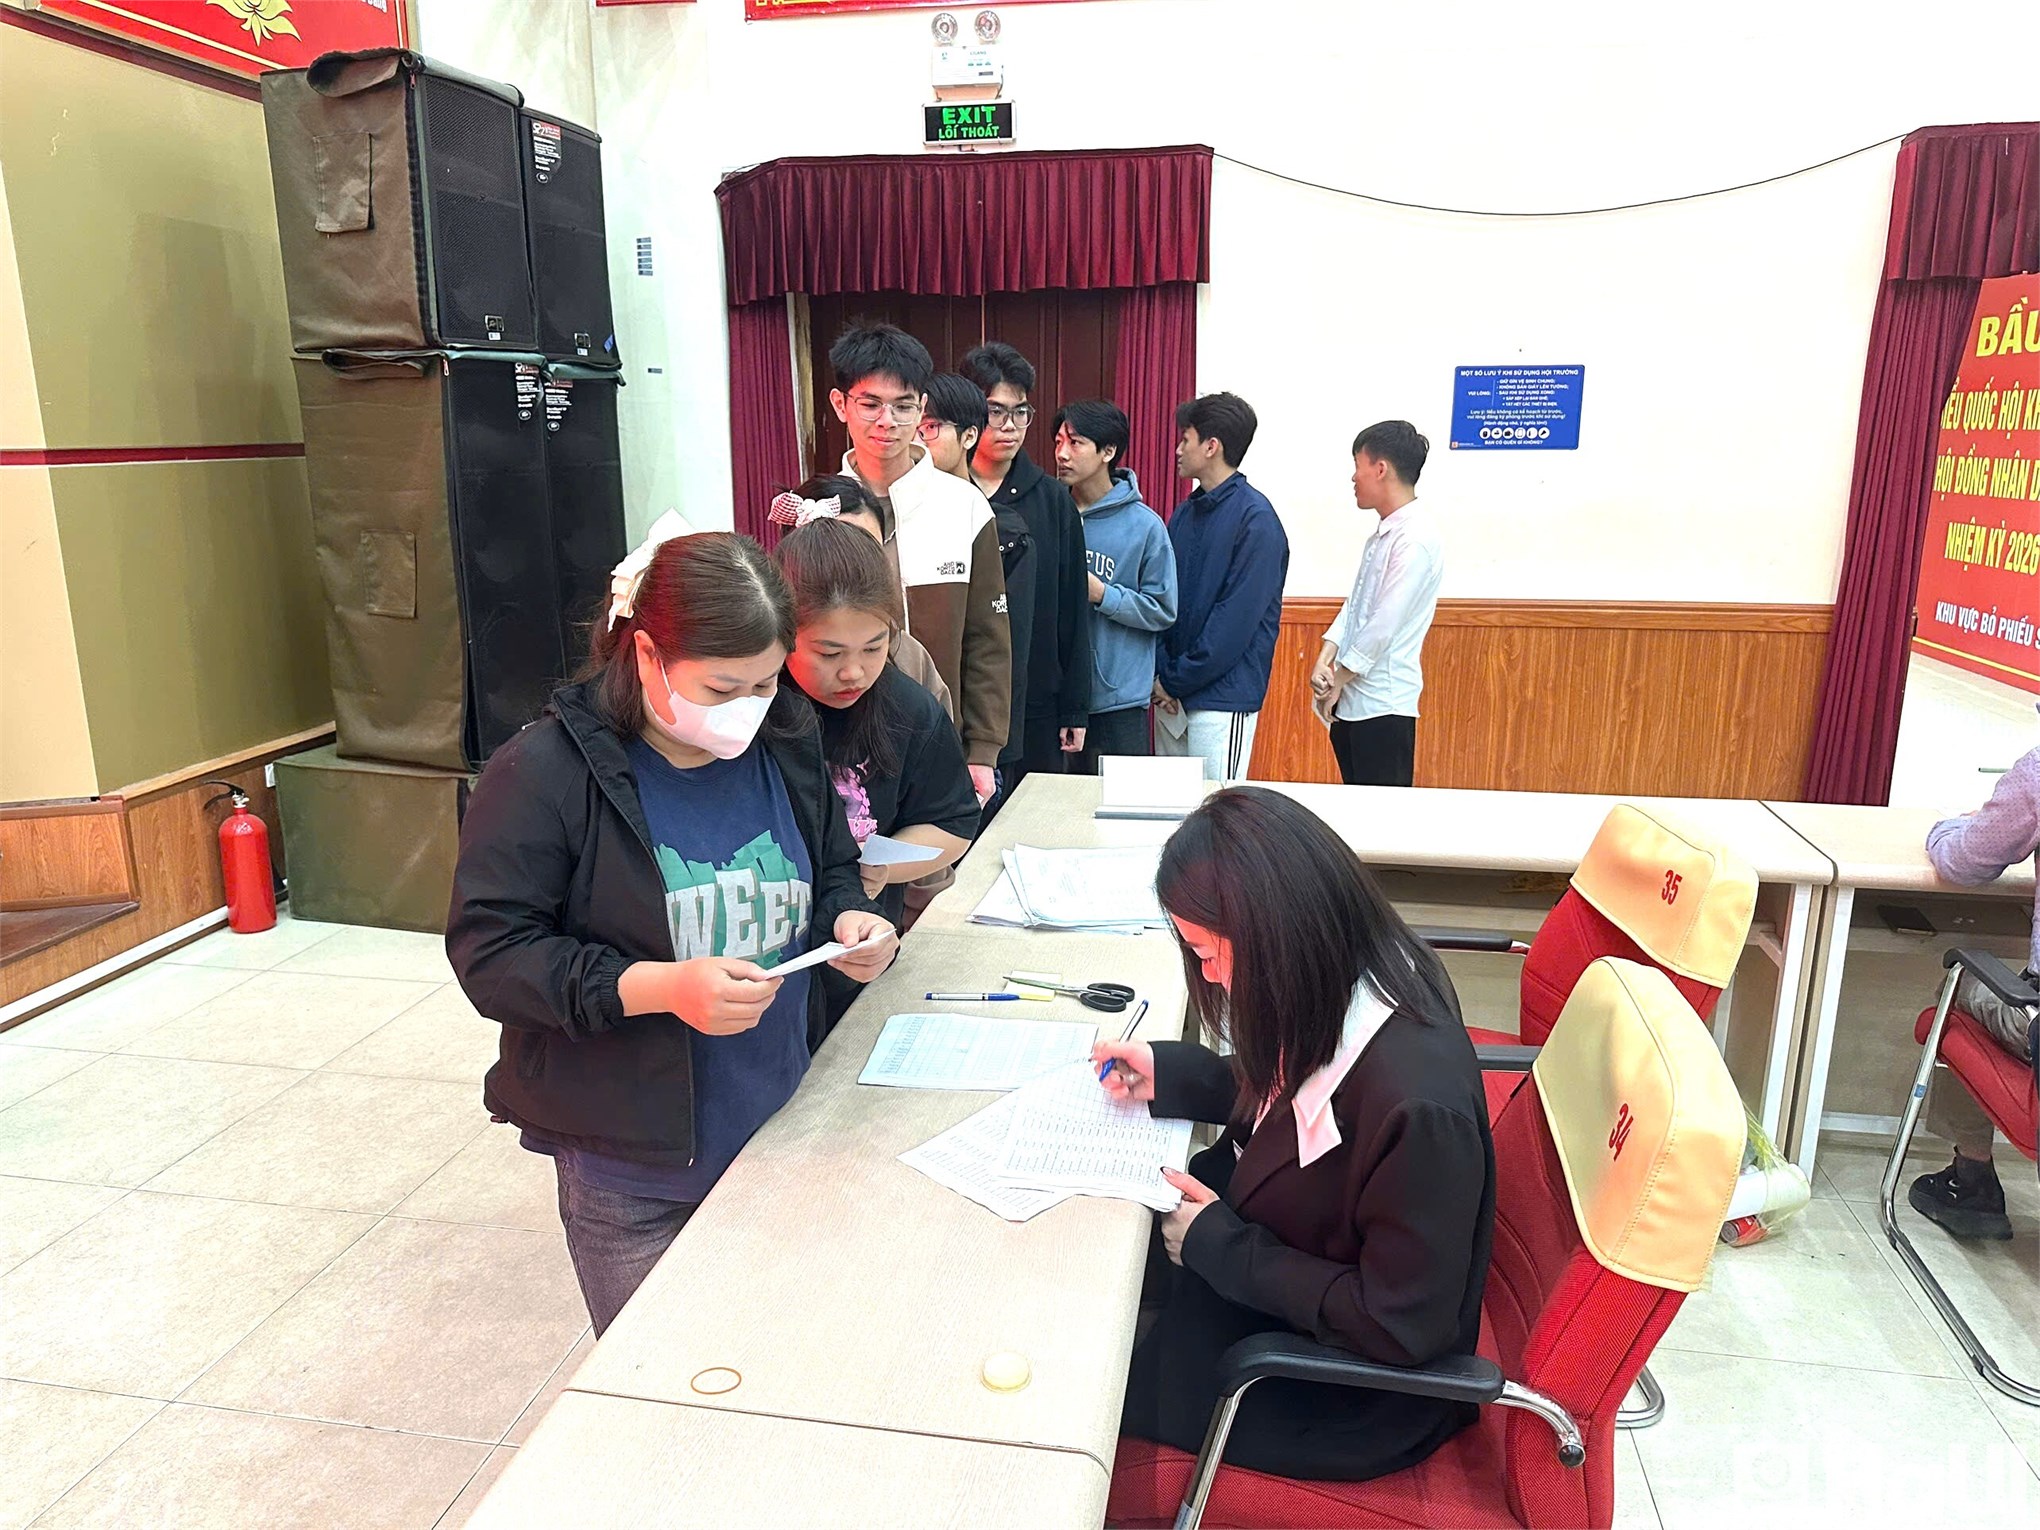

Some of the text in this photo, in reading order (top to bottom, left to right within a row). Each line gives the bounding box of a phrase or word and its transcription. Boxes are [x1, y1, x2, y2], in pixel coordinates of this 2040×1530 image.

[942, 106, 996, 125] EXIT
[960, 124, 999, 138] THOÁT
[1976, 296, 2040, 358] BẦU
[1963, 376, 1998, 434] QUỐC
[1997, 380, 2024, 440] HỘI
[1934, 447, 1955, 501] HỘI
[1954, 443, 1990, 496] ĐỒNG
[1989, 450, 2030, 500] NHÂN
[1944, 516, 1986, 571] NHIỆM
[1985, 520, 2006, 568] KỲ
[1935, 601, 1957, 625] KHU
[1958, 607, 1979, 633] VỰC
[1980, 606, 1997, 636] BỎ
[1997, 615, 2034, 646] PHIẾU
[1662, 869, 1682, 905] 35
[1609, 1103, 1634, 1162] 34
